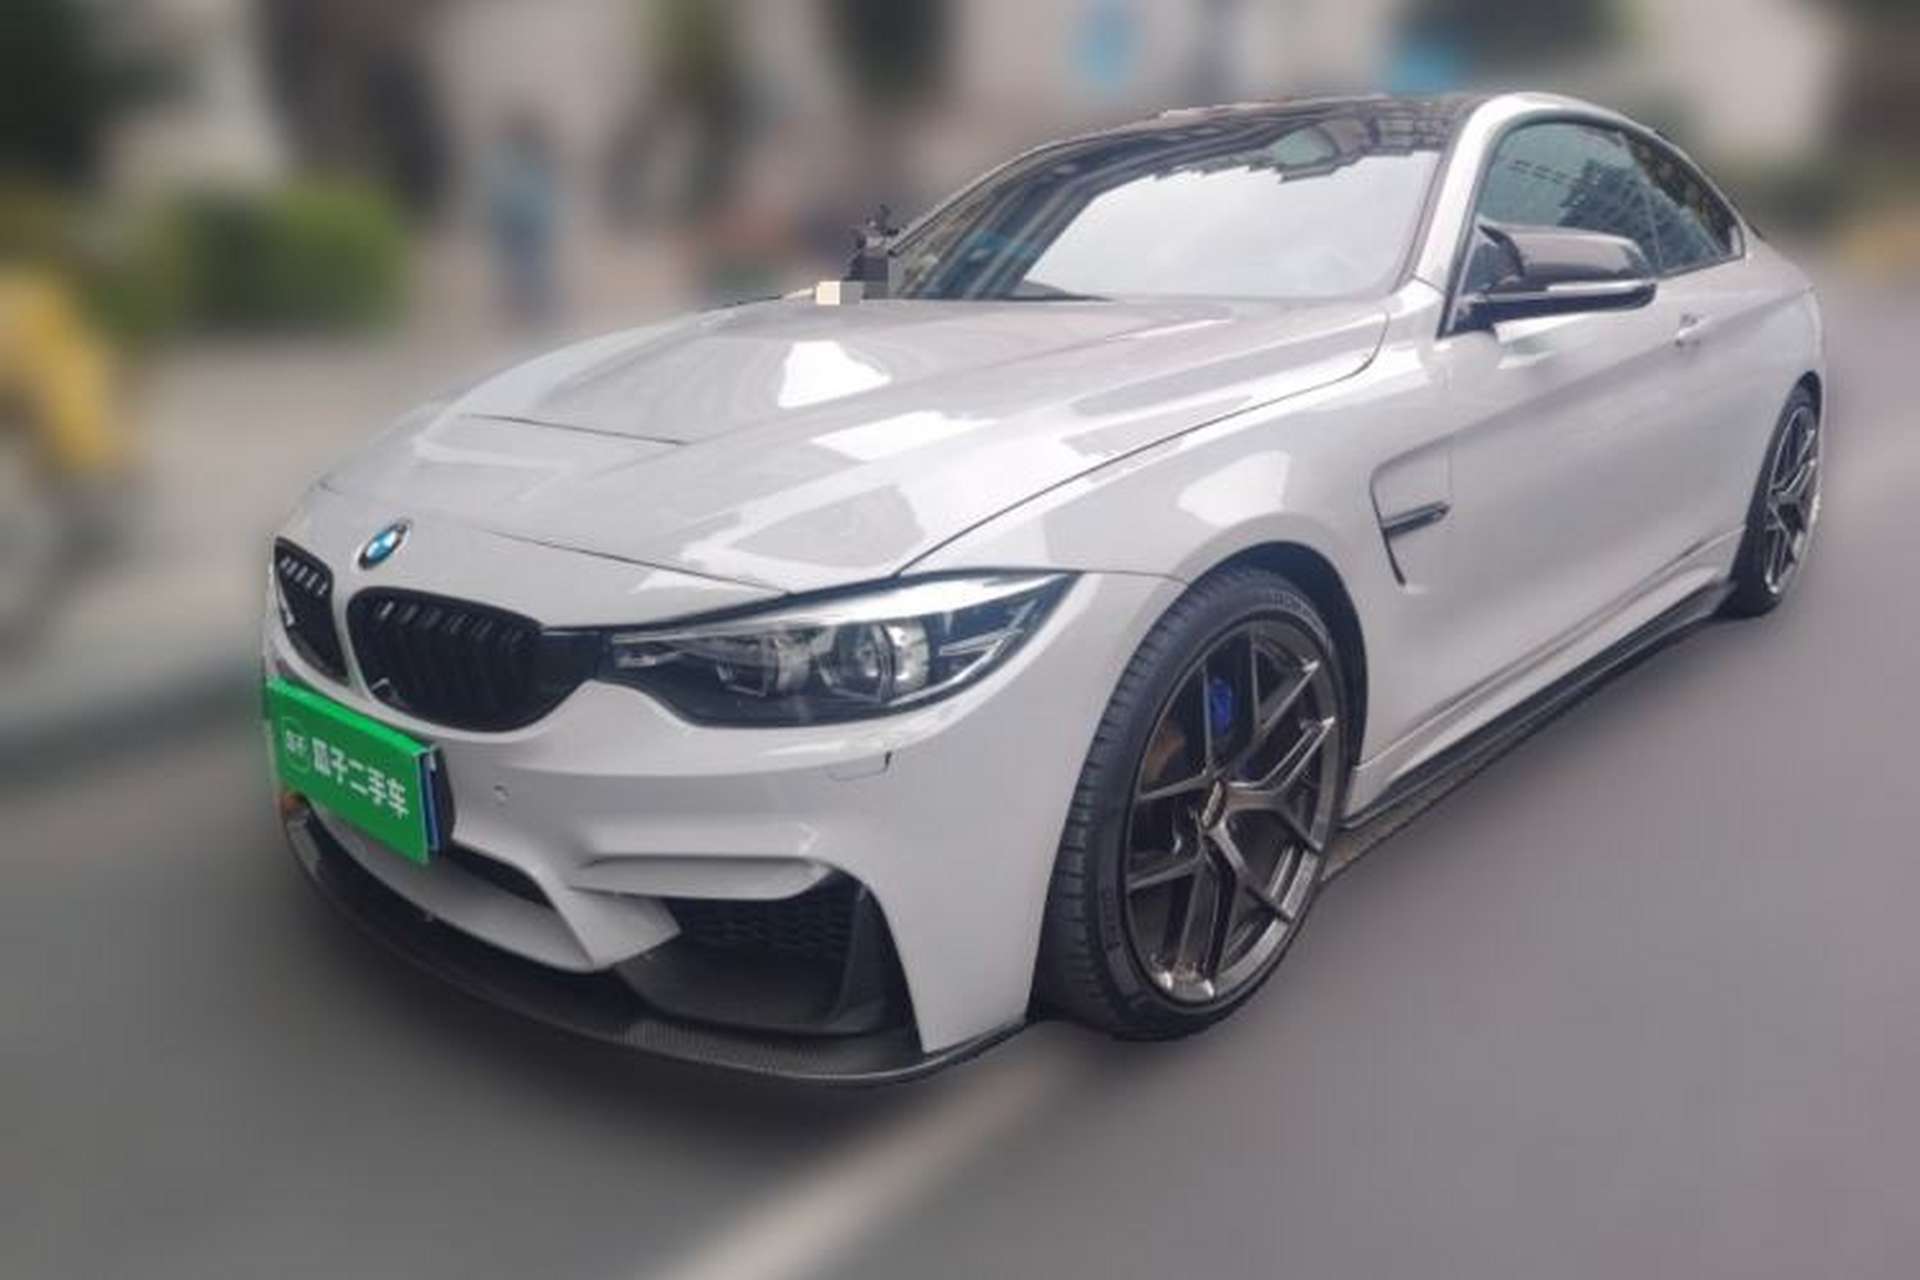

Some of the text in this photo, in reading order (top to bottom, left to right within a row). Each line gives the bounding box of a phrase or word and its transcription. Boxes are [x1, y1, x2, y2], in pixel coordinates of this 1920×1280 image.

[312, 737, 409, 820] 瓜子二手车
